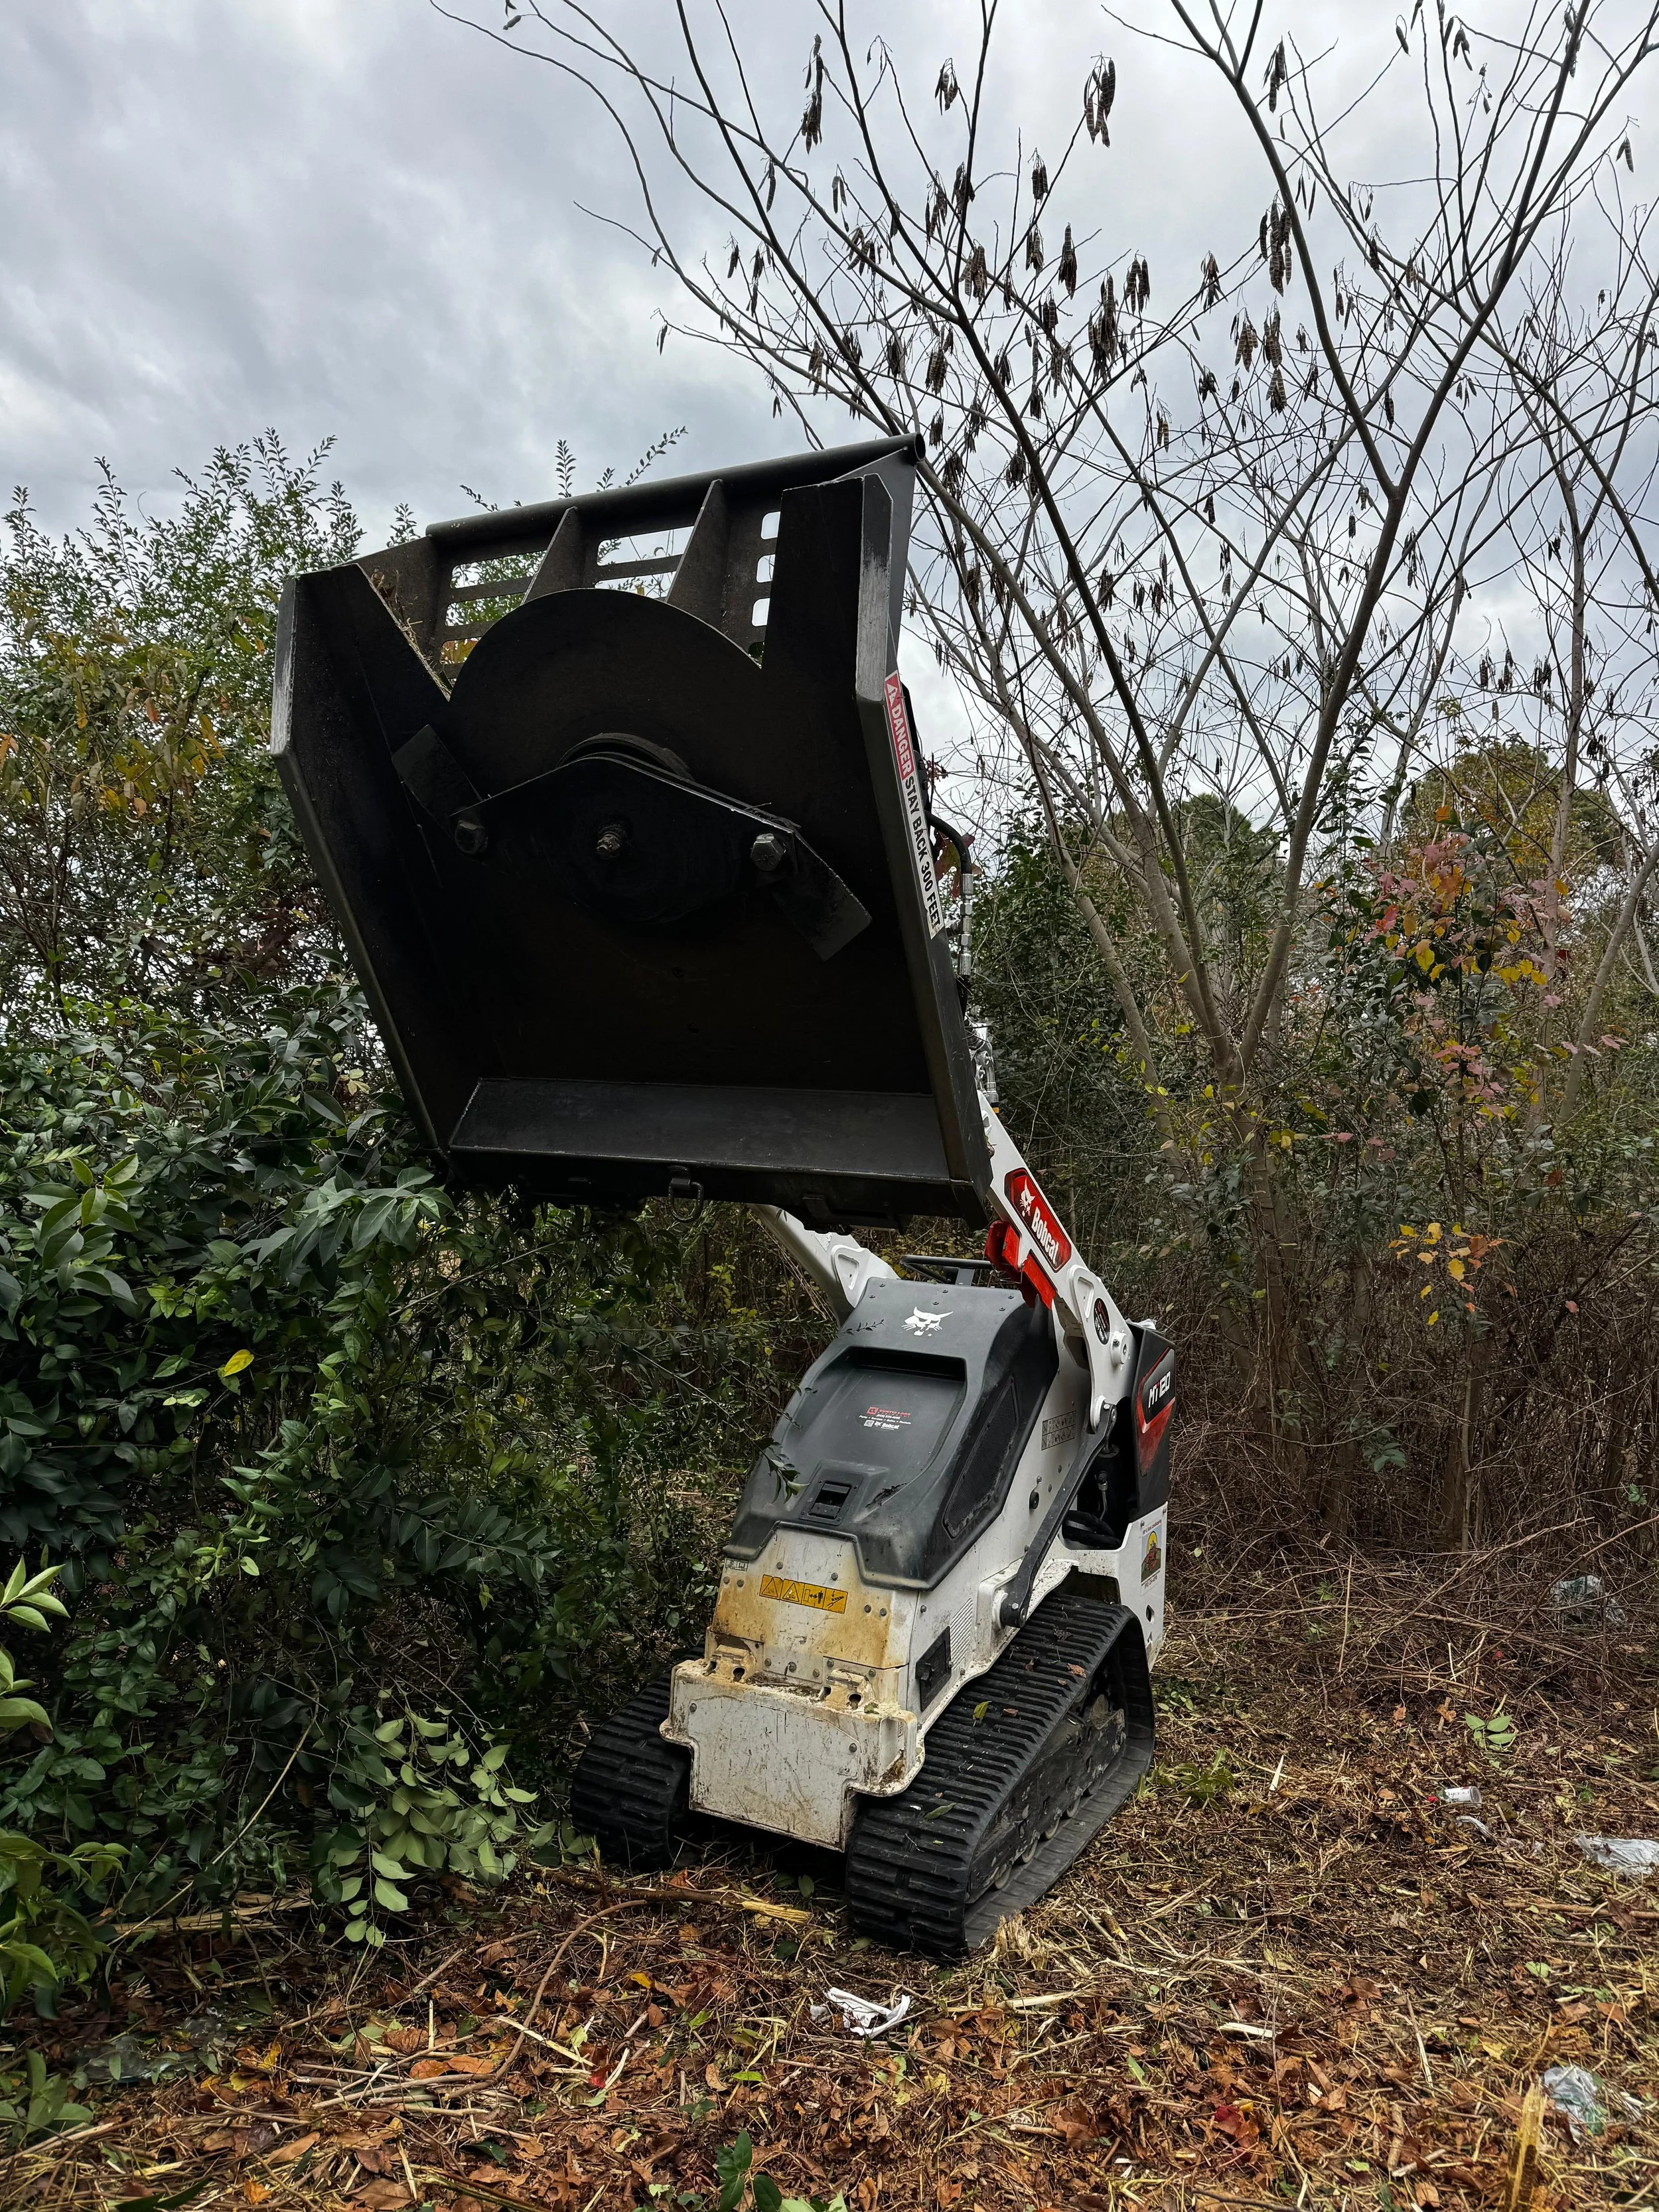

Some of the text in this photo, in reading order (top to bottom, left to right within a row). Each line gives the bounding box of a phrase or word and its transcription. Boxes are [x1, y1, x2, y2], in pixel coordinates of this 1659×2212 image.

[891, 703, 941, 928] DANGER STAY BACK 300 FEET
[1031, 1206, 1059, 1264] Bobcat
